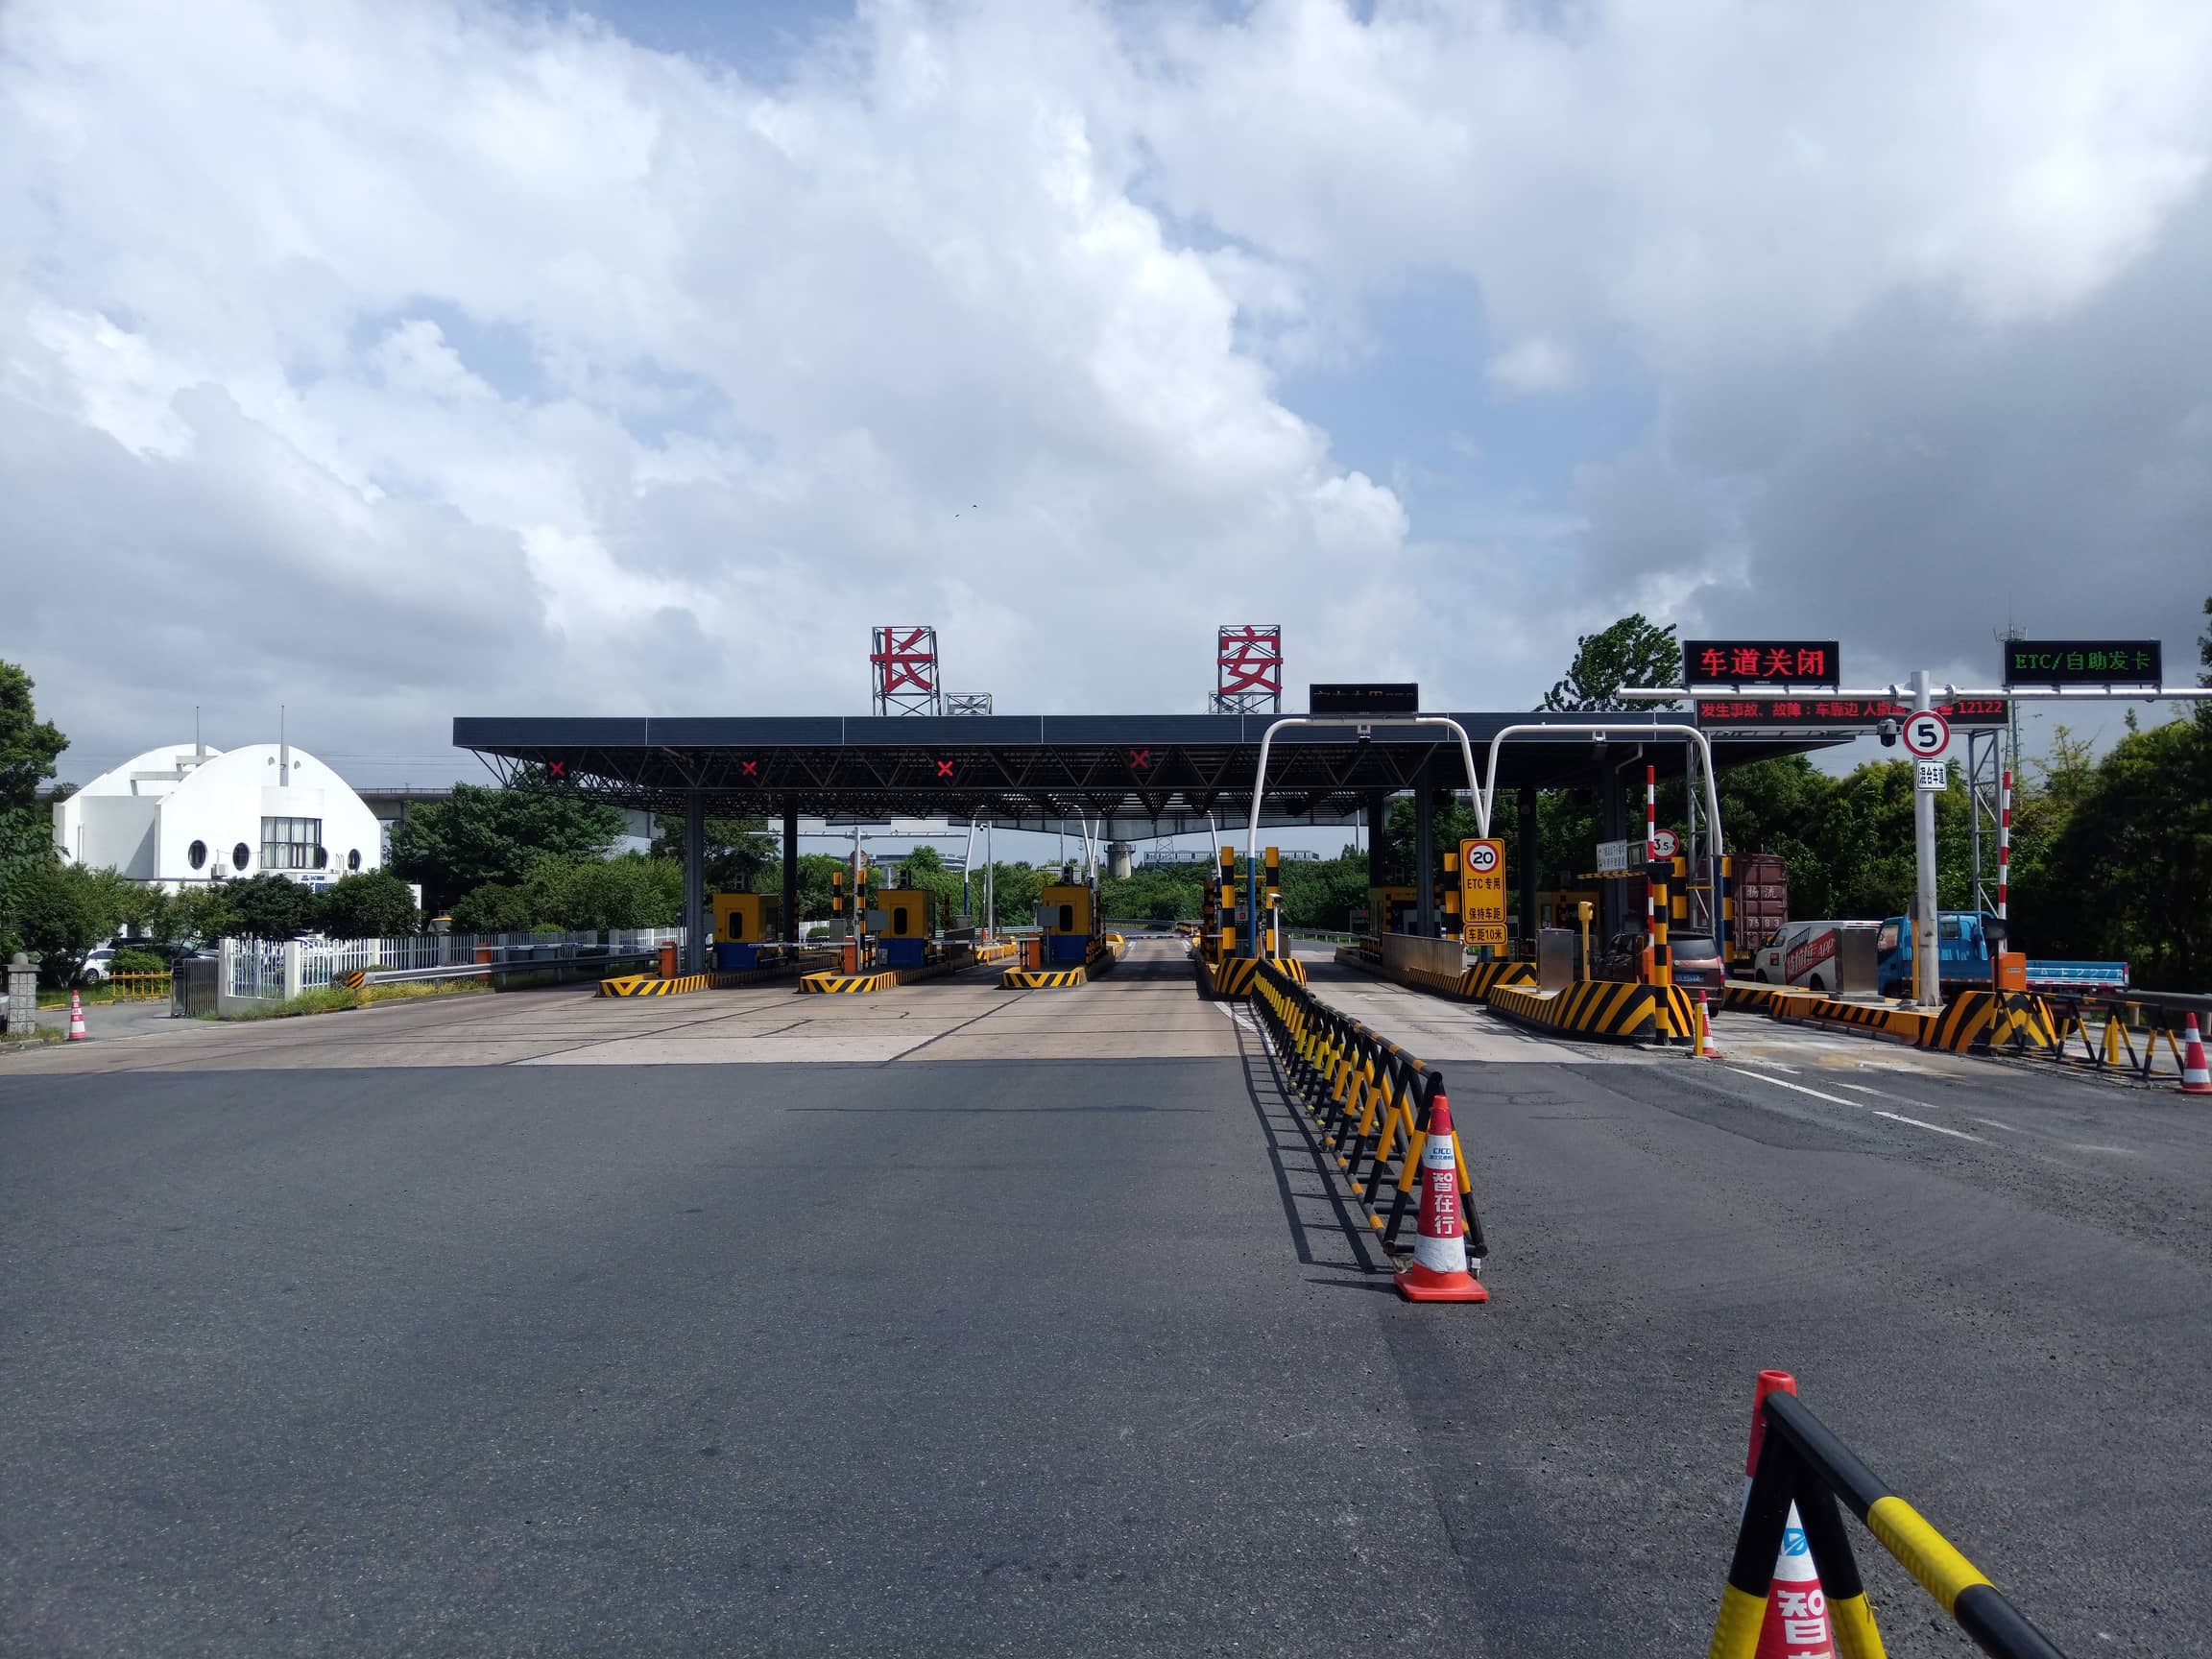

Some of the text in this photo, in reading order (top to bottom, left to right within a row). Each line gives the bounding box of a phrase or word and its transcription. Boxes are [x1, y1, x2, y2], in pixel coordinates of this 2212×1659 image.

[1700, 647, 1825, 678] 车道关闭
[2014, 651, 2152, 671] ETC/自助发卡
[1959, 701, 2003, 714] 12122
[1917, 723, 1937, 748] 5
[1919, 766, 1945, 785] 混合车道
[1473, 851, 1494, 864] 20
[1467, 877, 1501, 891] ETC 专用
[1469, 907, 1502, 921] 保持车距
[1468, 927, 1503, 941] 车距10米
[1777, 1589, 1830, 1659] 智
